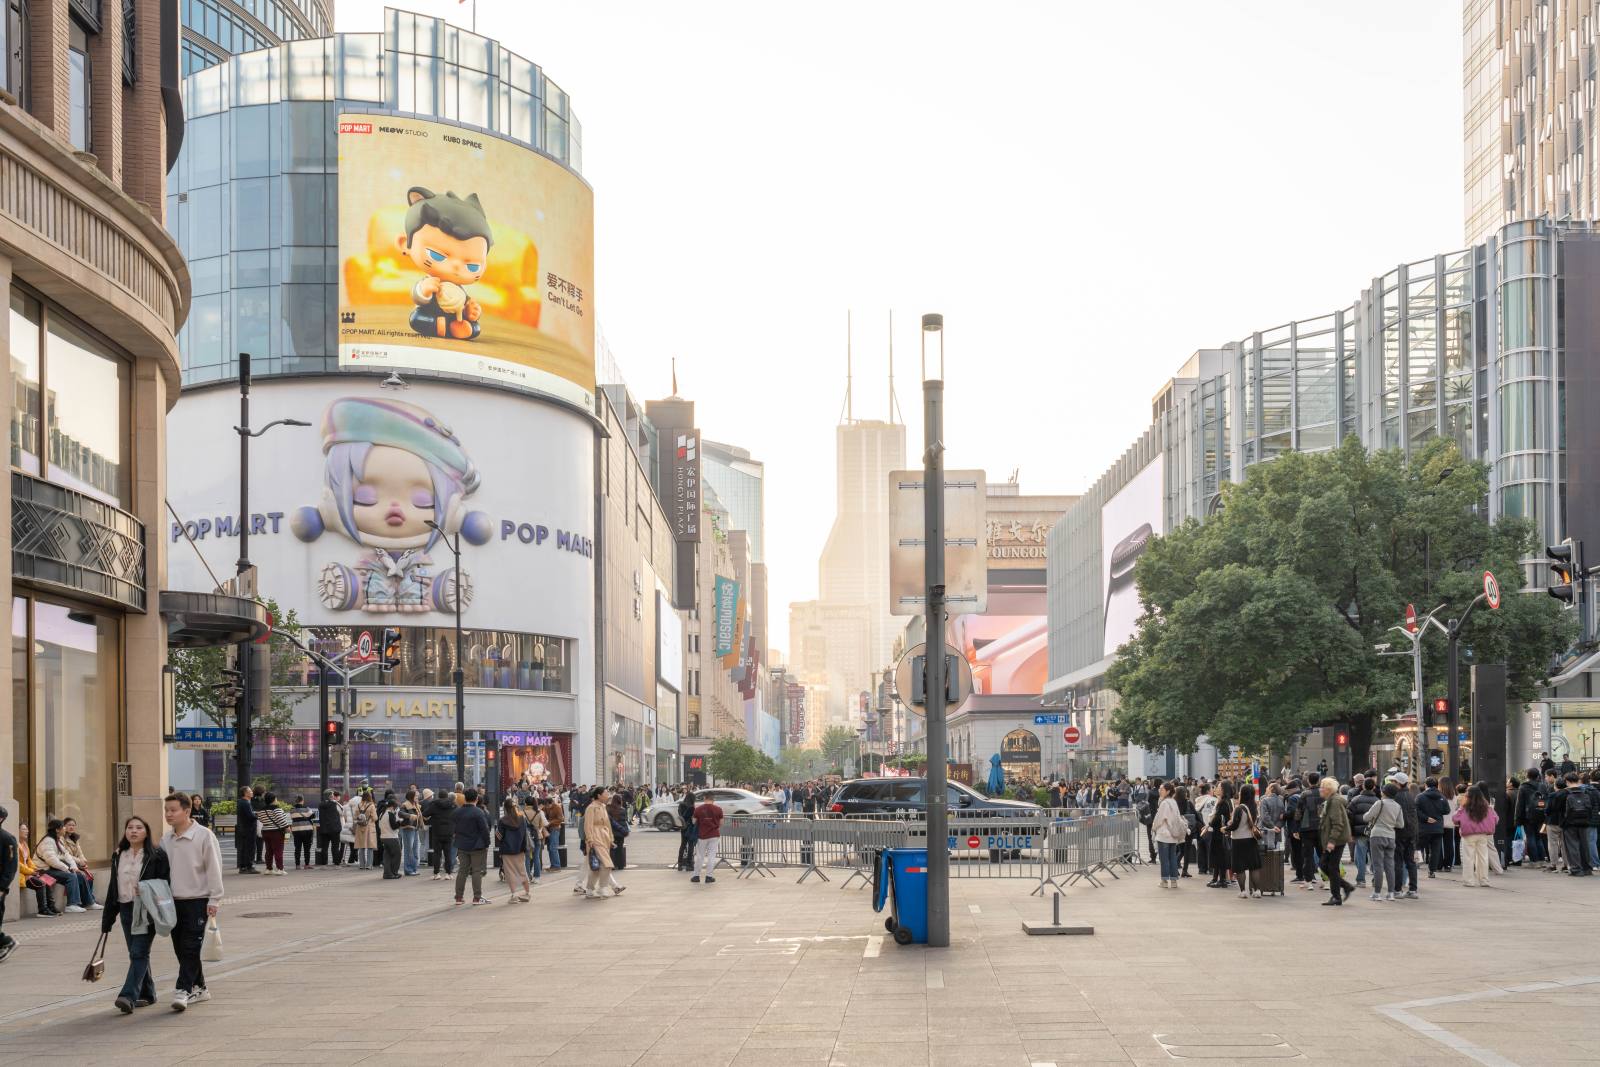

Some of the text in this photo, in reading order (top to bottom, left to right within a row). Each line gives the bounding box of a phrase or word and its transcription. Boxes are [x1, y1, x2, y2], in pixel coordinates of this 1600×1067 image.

[340, 124, 371, 133] POP MART
[405, 130, 428, 138] STUDIO
[548, 291, 565, 307] Can't
[677, 506, 685, 535] PLAZA
[501, 519, 549, 546] POP
[1488, 580, 1497, 601] 40
[360, 639, 370, 654] 40
[502, 735, 552, 746] POP MART
[988, 836, 1032, 849] POLICE
